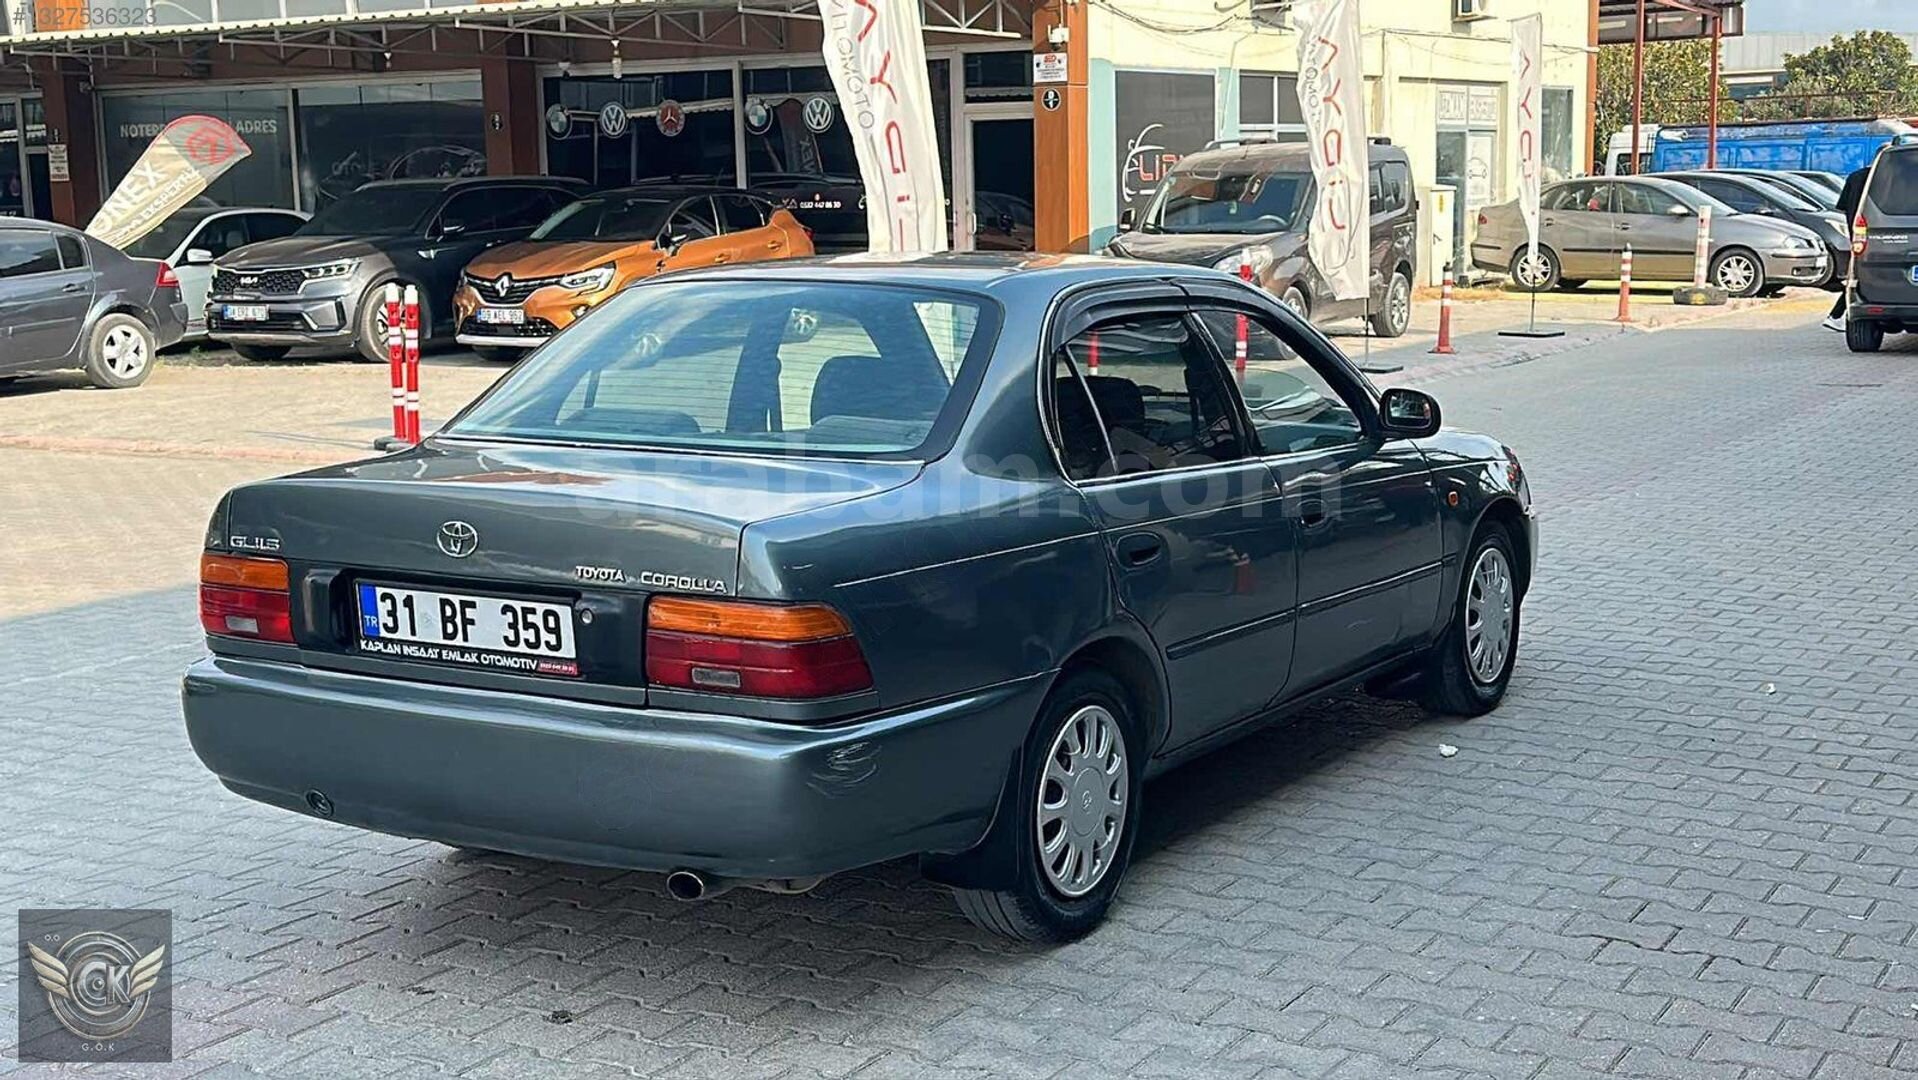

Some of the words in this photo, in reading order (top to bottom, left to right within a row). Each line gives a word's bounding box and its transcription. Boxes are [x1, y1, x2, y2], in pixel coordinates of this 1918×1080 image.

[236, 119, 278, 133] ADRES
[575, 565, 625, 582] TOYOTA
[640, 571, 728, 594] COROLLA
[364, 615, 378, 628] TR
[380, 592, 417, 637] 31
[439, 597, 477, 642] BF
[501, 604, 562, 652] 359
[360, 639, 401, 655] KAPLAN
[402, 644, 440, 659] INSAAT
[441, 649, 479, 663] EMLAK
[480, 653, 538, 670] OTOMOTIV
